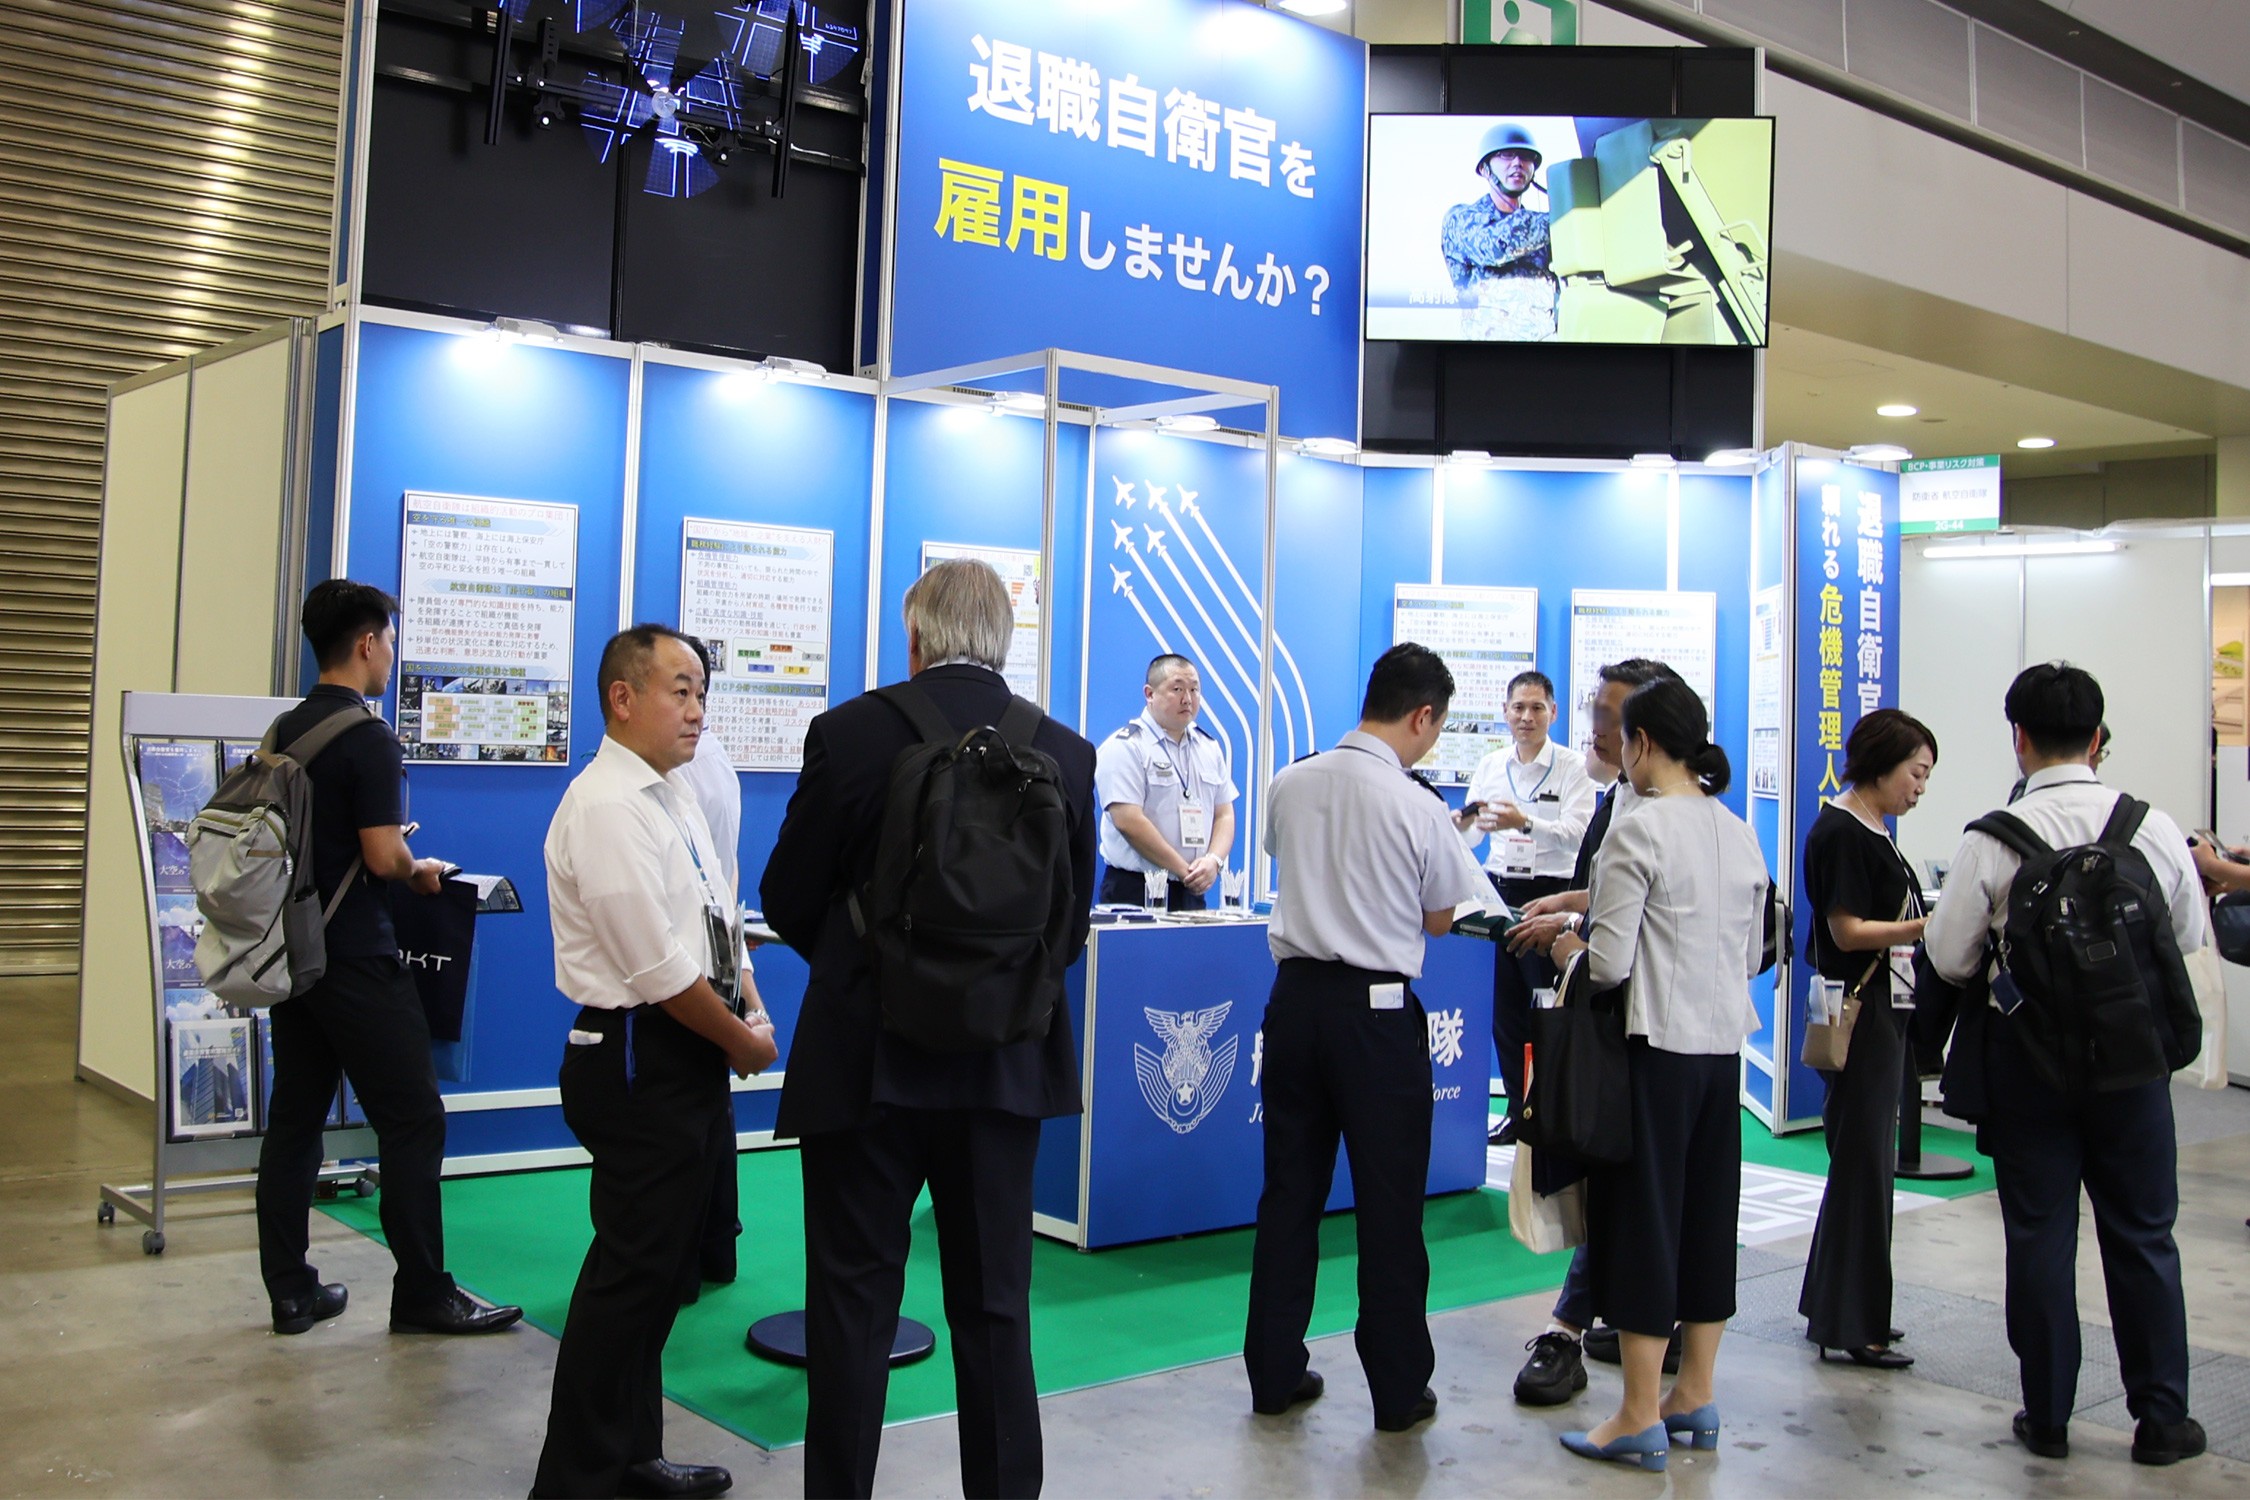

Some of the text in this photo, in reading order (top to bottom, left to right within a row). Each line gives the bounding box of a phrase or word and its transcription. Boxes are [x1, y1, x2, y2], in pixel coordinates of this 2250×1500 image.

[967, 33, 1317, 200] 退職自衛官を
[1935, 520, 1964, 531] 2G-44
[1818, 483, 1844, 813] 頼れる危機管理人
